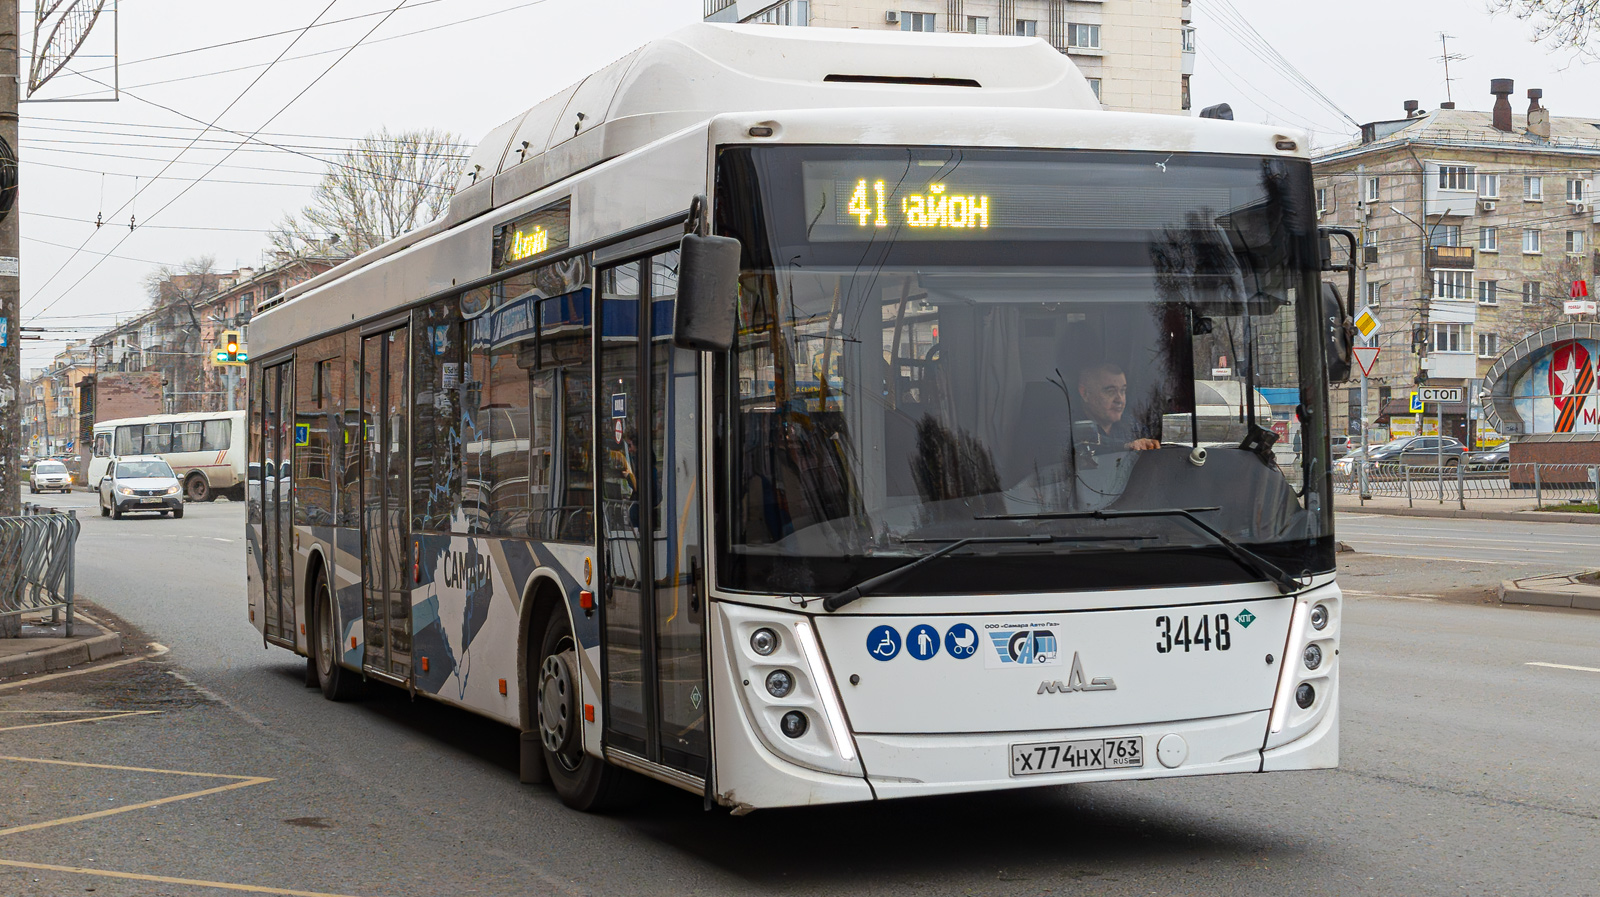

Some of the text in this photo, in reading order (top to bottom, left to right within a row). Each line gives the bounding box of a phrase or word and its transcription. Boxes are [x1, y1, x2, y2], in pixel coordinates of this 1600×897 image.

[848, 179, 888, 227] 41
[1423, 389, 1458, 400] СТОП
[1584, 408, 1600, 425] М
[444, 550, 493, 591] САМАРА
[1156, 613, 1231, 654] 3448
[1020, 740, 1138, 771] Х774НХ 763
